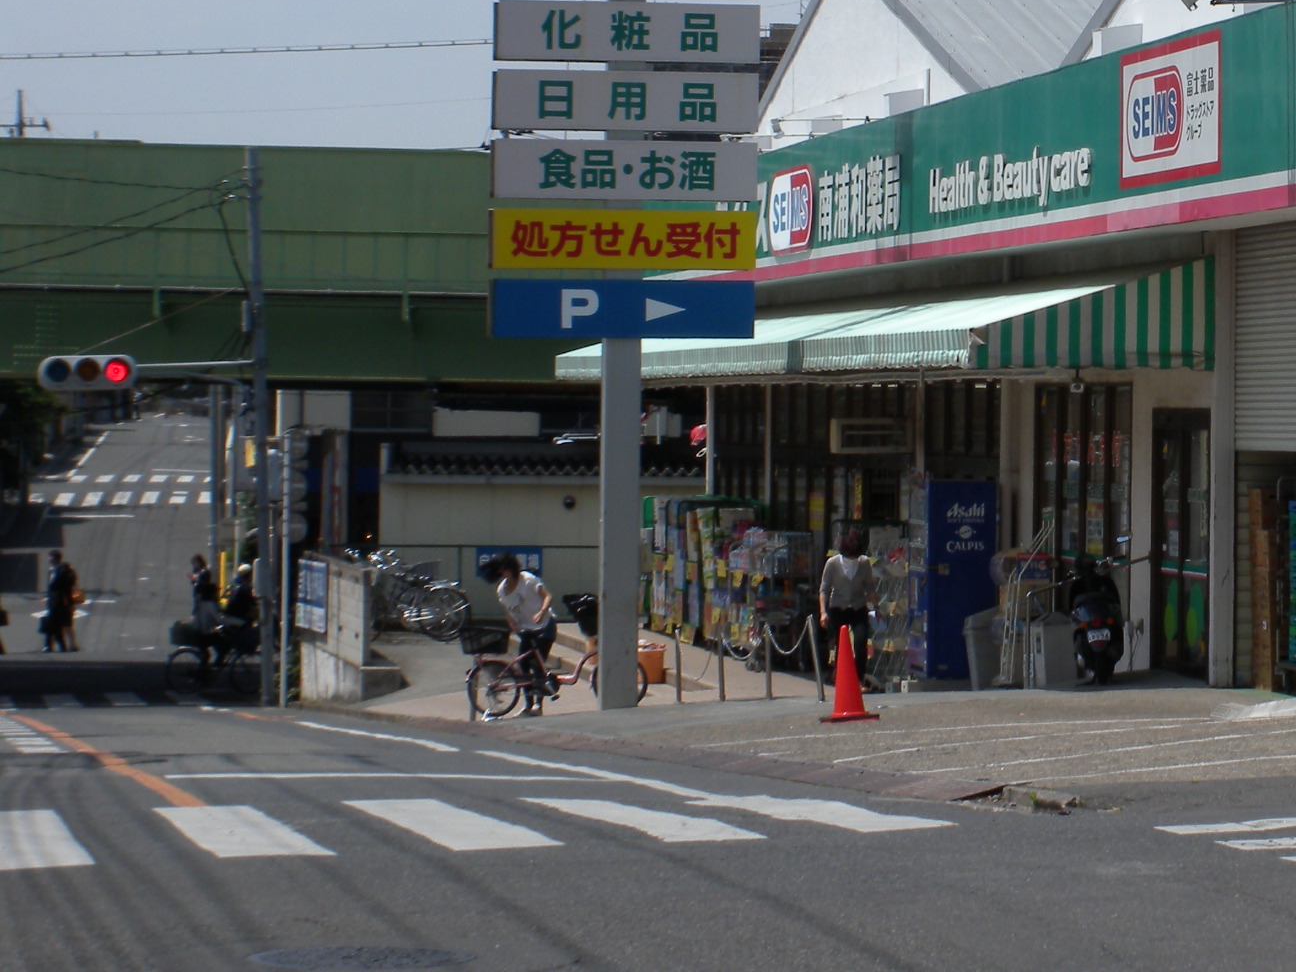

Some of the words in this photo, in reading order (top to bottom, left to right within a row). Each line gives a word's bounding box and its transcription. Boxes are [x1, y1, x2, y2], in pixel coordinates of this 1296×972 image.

[540, 9, 719, 52] 化粧品
[538, 80, 718, 123] 日用品
[1132, 87, 1178, 140] SEIMS
[818, 154, 901, 242] 南浦和薬局
[928, 166, 976, 214] Health
[977, 155, 991, 205] &
[992, 144, 1049, 207] Beauty
[1050, 147, 1091, 192] care
[772, 183, 809, 234] SEIMS
[511, 220, 741, 260] 処方せん受付
[561, 288, 600, 329] P
[946, 502, 986, 518] Asahi
[946, 540, 985, 553] CALPIS
